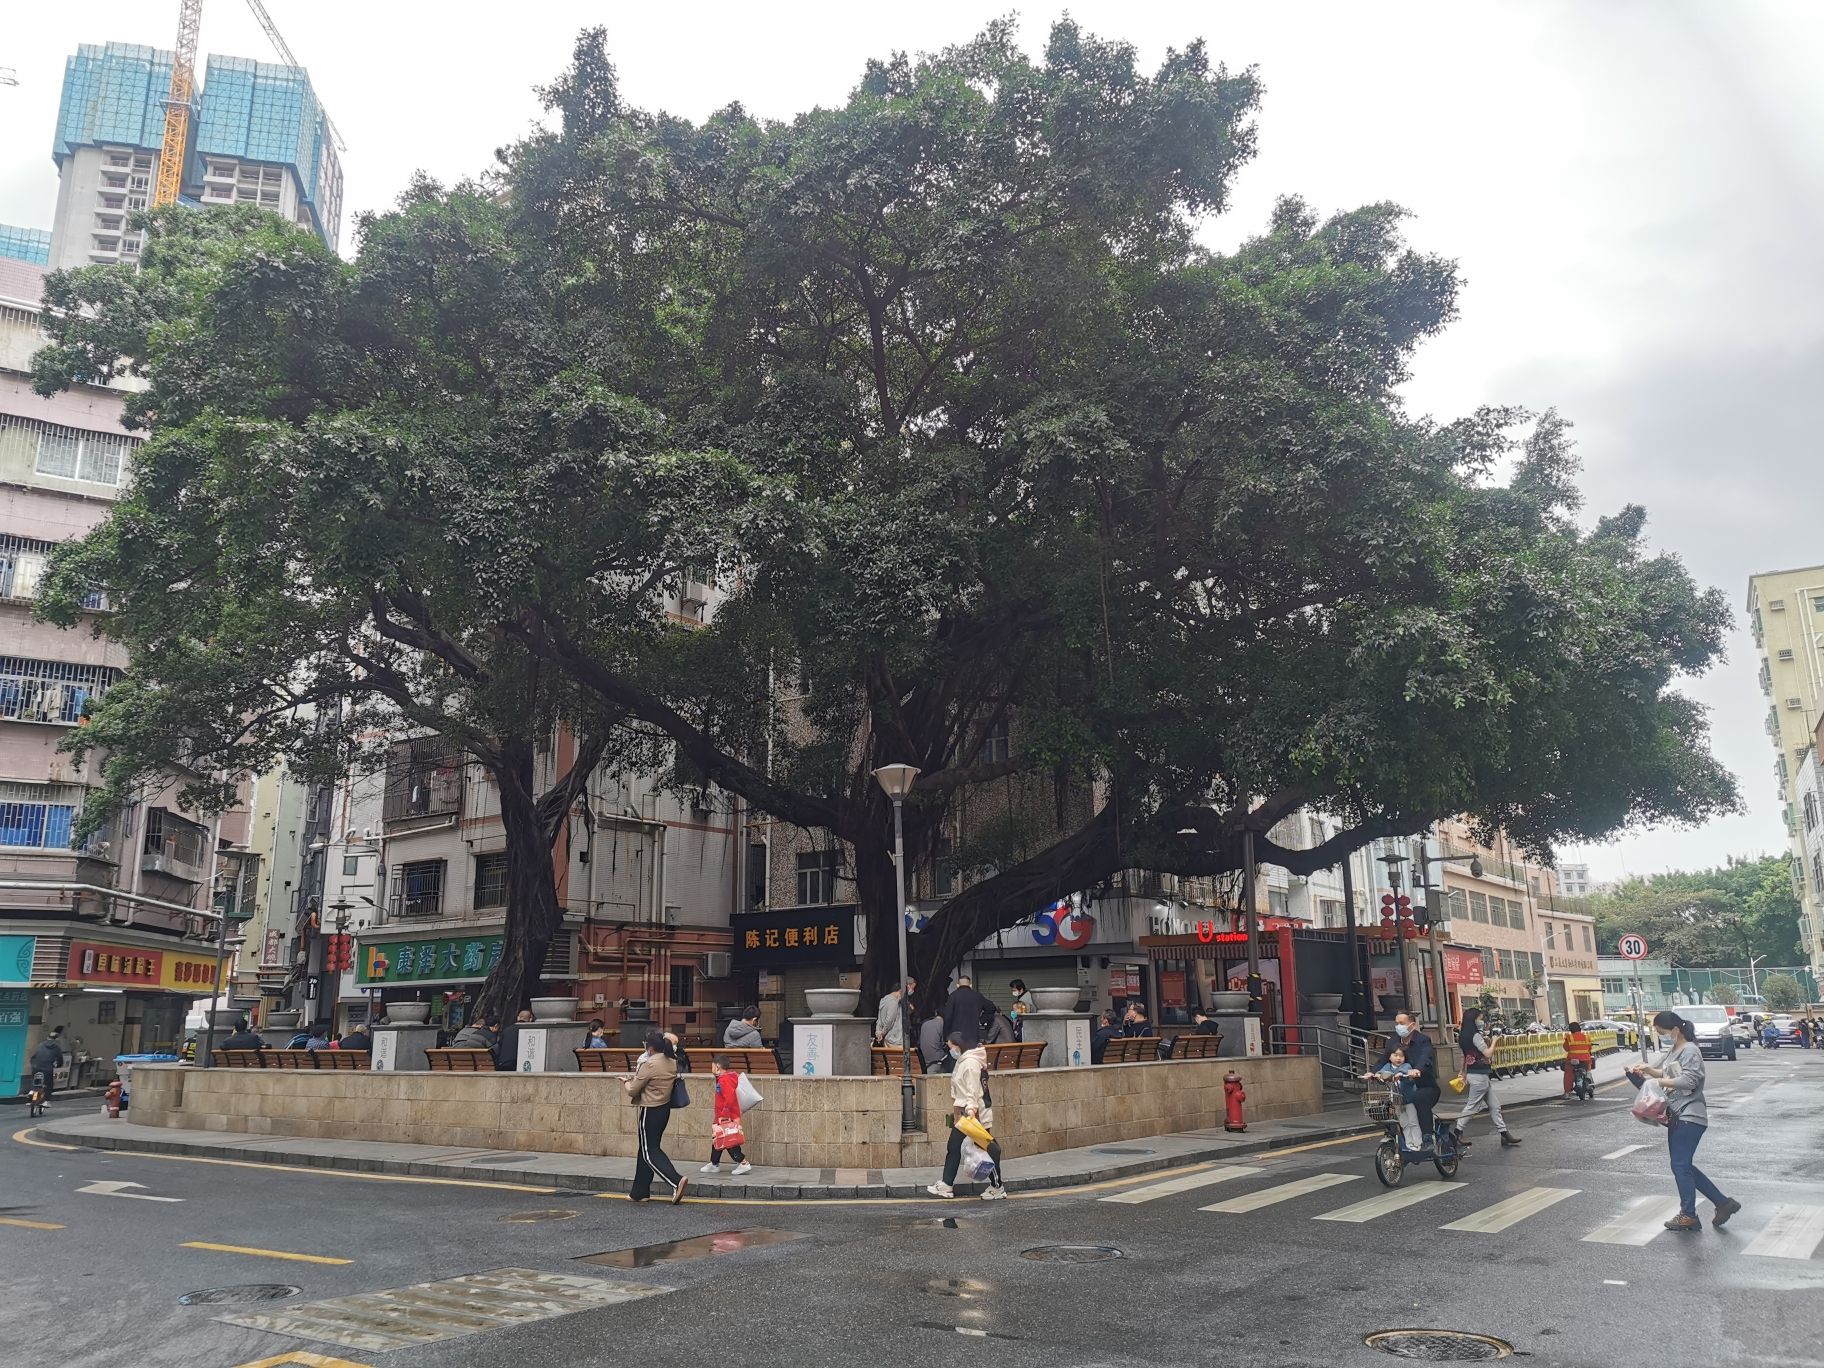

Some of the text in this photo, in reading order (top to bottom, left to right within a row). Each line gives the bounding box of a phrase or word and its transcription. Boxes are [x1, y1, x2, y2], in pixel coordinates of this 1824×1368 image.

[745, 924, 840, 949] 陈记便利店
[1031, 900, 1097, 950] 5G
[1197, 919, 1249, 943] U station
[1625, 939, 1641, 955] 30
[807, 1032, 818, 1061] 友善
